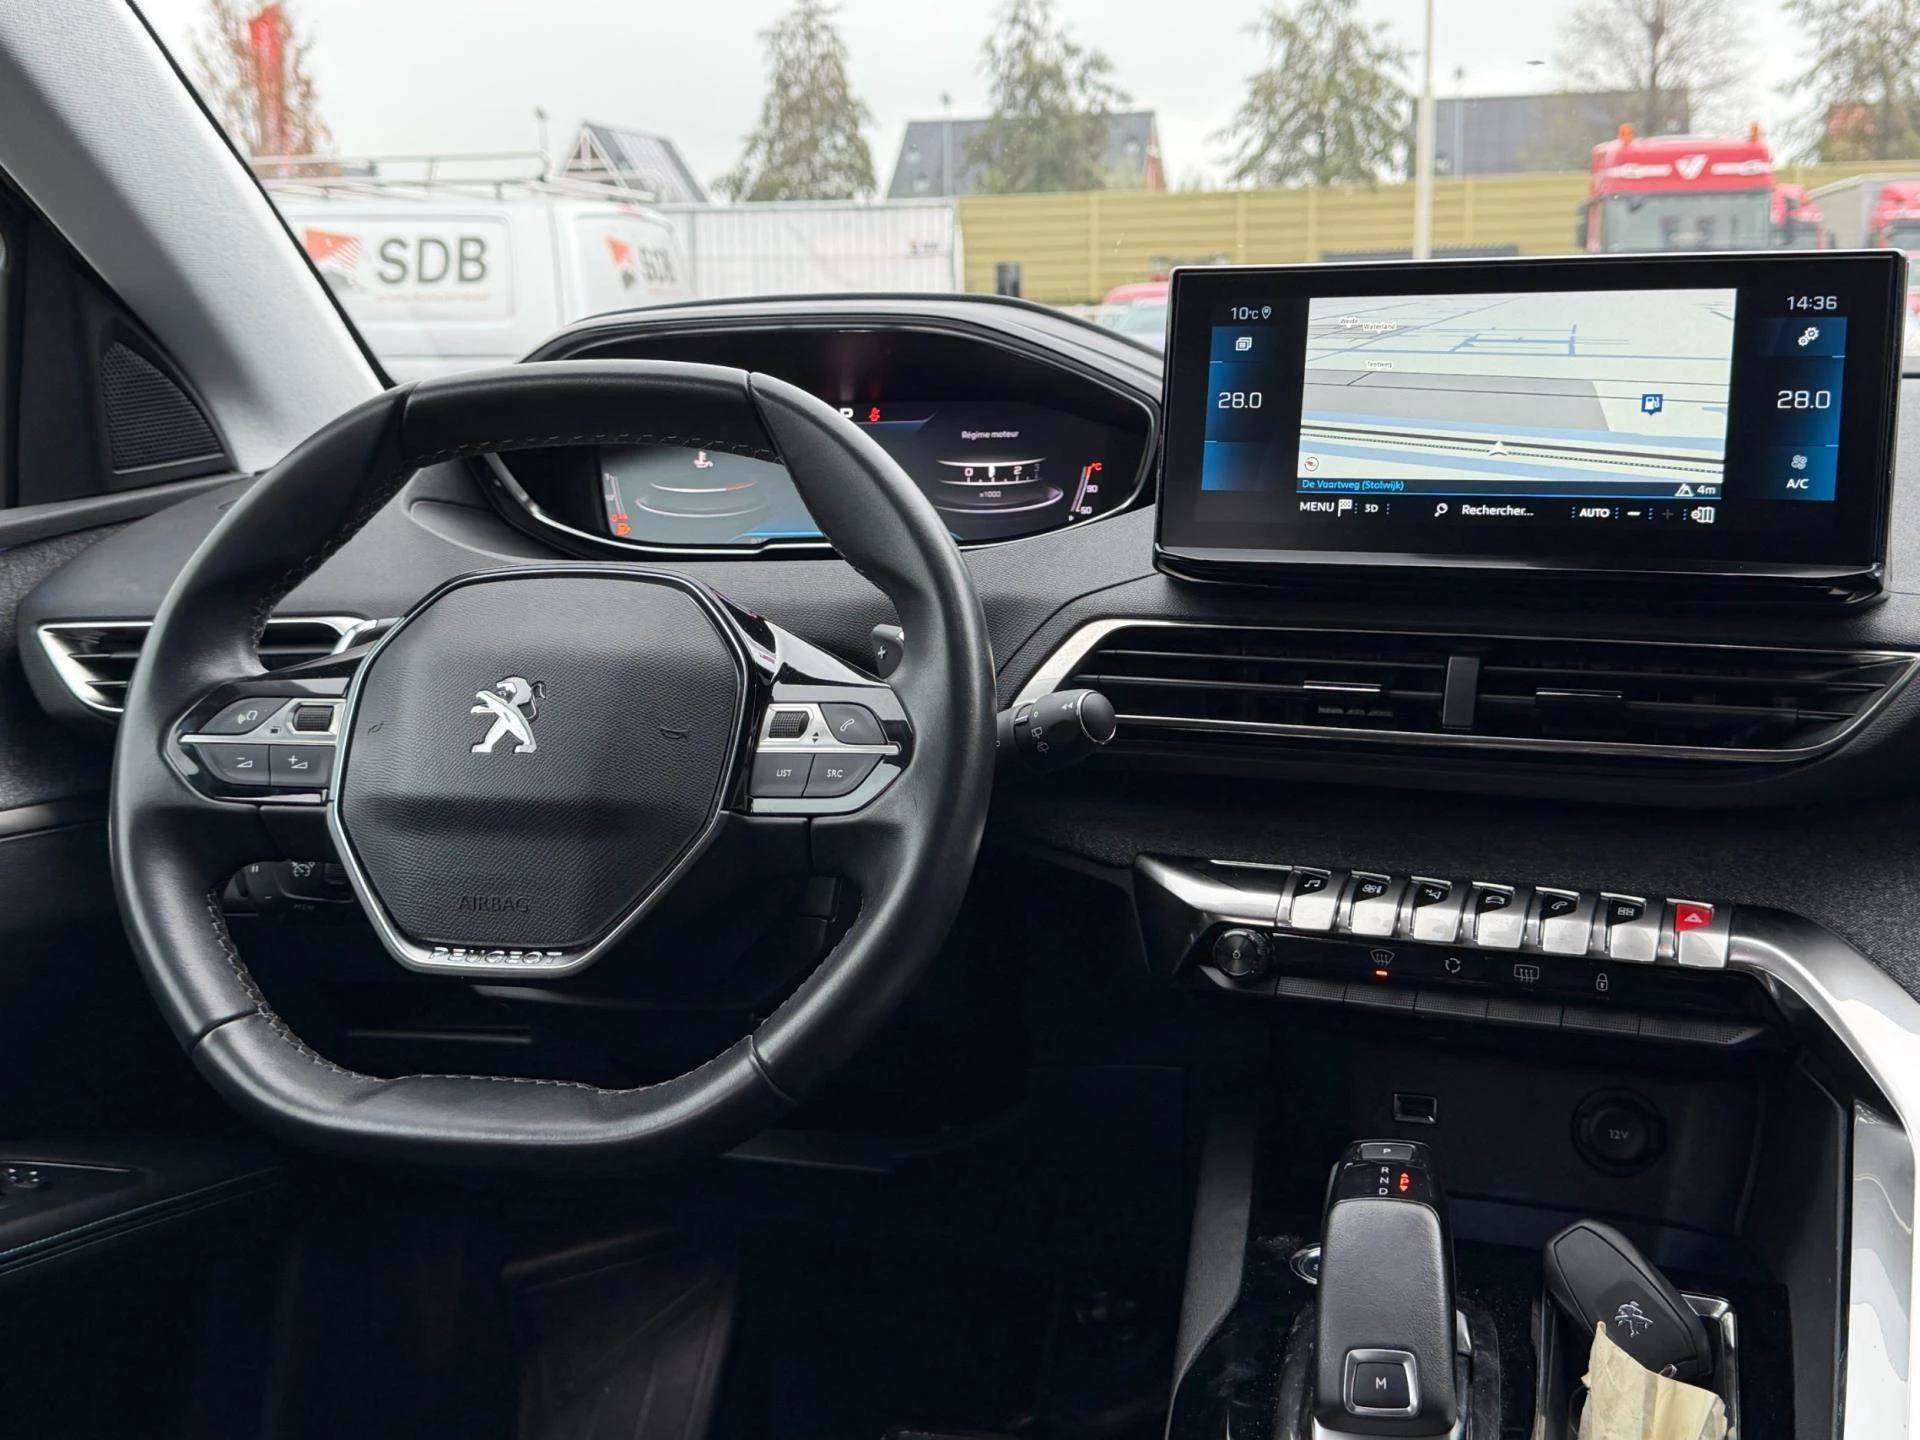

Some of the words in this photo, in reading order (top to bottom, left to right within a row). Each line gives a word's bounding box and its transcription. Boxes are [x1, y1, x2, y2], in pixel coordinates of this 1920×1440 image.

[377, 237, 487, 284] SDB
[1786, 296, 1839, 310] 14:36
[1218, 391, 1263, 409] 28.0
[1777, 390, 1831, 409] 28.0
[961, 430, 990, 441] Régime
[990, 430, 1020, 439] moteur
[1302, 480, 1315, 489] De
[1317, 480, 1360, 491] Vaartweg
[1362, 480, 1405, 492] (Stolwijk)
[1697, 485, 1717, 495] 4m
[1786, 478, 1810, 490] A/C
[1299, 502, 1335, 513] MENU
[1364, 503, 1380, 513] 3D
[1462, 504, 1535, 517] Rechercher...
[1579, 507, 1611, 519] AUTO
[776, 768, 792, 778] LIST
[826, 768, 844, 779] SRC
[459, 895, 531, 913] AIRBAG
[428, 946, 563, 965] PEUGEOT
[1608, 1128, 1630, 1140] 12V
[1380, 1166, 1390, 1174] R
[1379, 1176, 1390, 1184] N
[1378, 1187, 1389, 1196] D
[1375, 1376, 1388, 1390] M
